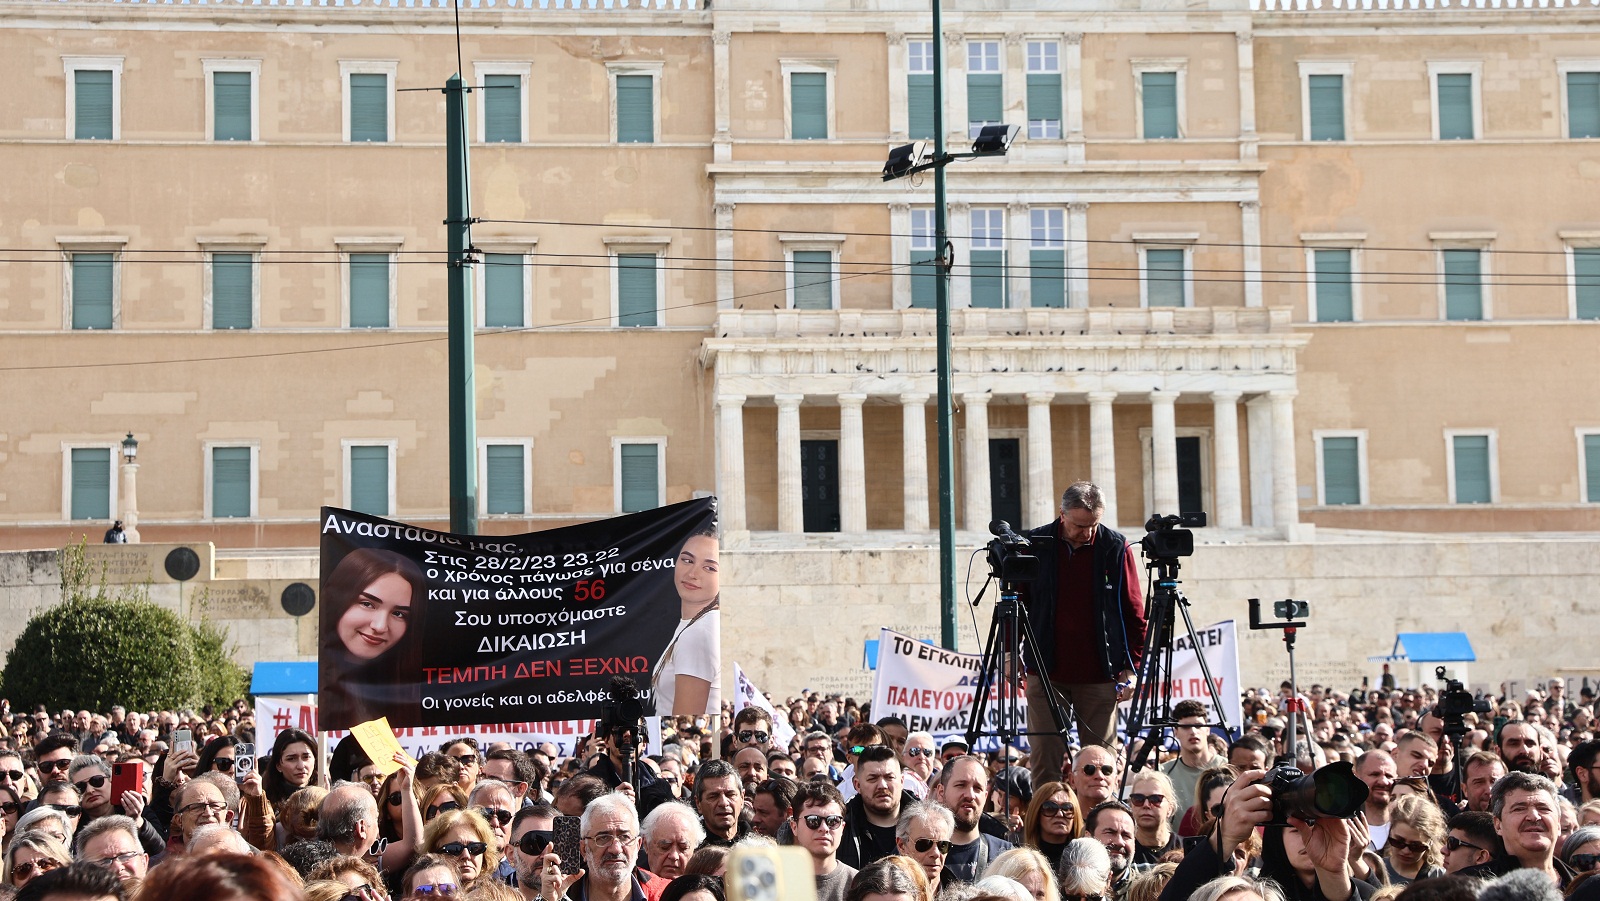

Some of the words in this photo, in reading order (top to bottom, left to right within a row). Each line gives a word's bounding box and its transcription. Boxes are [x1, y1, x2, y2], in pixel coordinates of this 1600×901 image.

[424, 550, 467, 569] Στις
[475, 553, 556, 570] 28/2/23
[563, 547, 620, 567] 23.22
[426, 569, 439, 580] ο
[441, 567, 513, 586] χρόνος
[519, 566, 594, 585] πάγωσε
[598, 561, 627, 578] για
[631, 555, 675, 573] σένα
[427, 587, 457, 601] και
[461, 587, 490, 603] για
[495, 583, 564, 602] άλλους
[574, 579, 606, 601] 56
[454, 610, 492, 626] Σου
[498, 603, 627, 627] υποσχόμαστε
[477, 630, 587, 653] ΔΙΚΑΙΩΣΗ
[893, 636, 914, 656] ΤΟ
[422, 665, 507, 685] ΤΕΜΠΗ
[513, 659, 562, 680] ΔΕΝ
[569, 656, 649, 676] ΞΕΧΝΩ
[421, 696, 440, 710] Οι
[444, 692, 494, 711] γονείς
[499, 694, 523, 706] και
[527, 694, 543, 705] οι
[934, 711, 969, 731] ΜΑΣ
